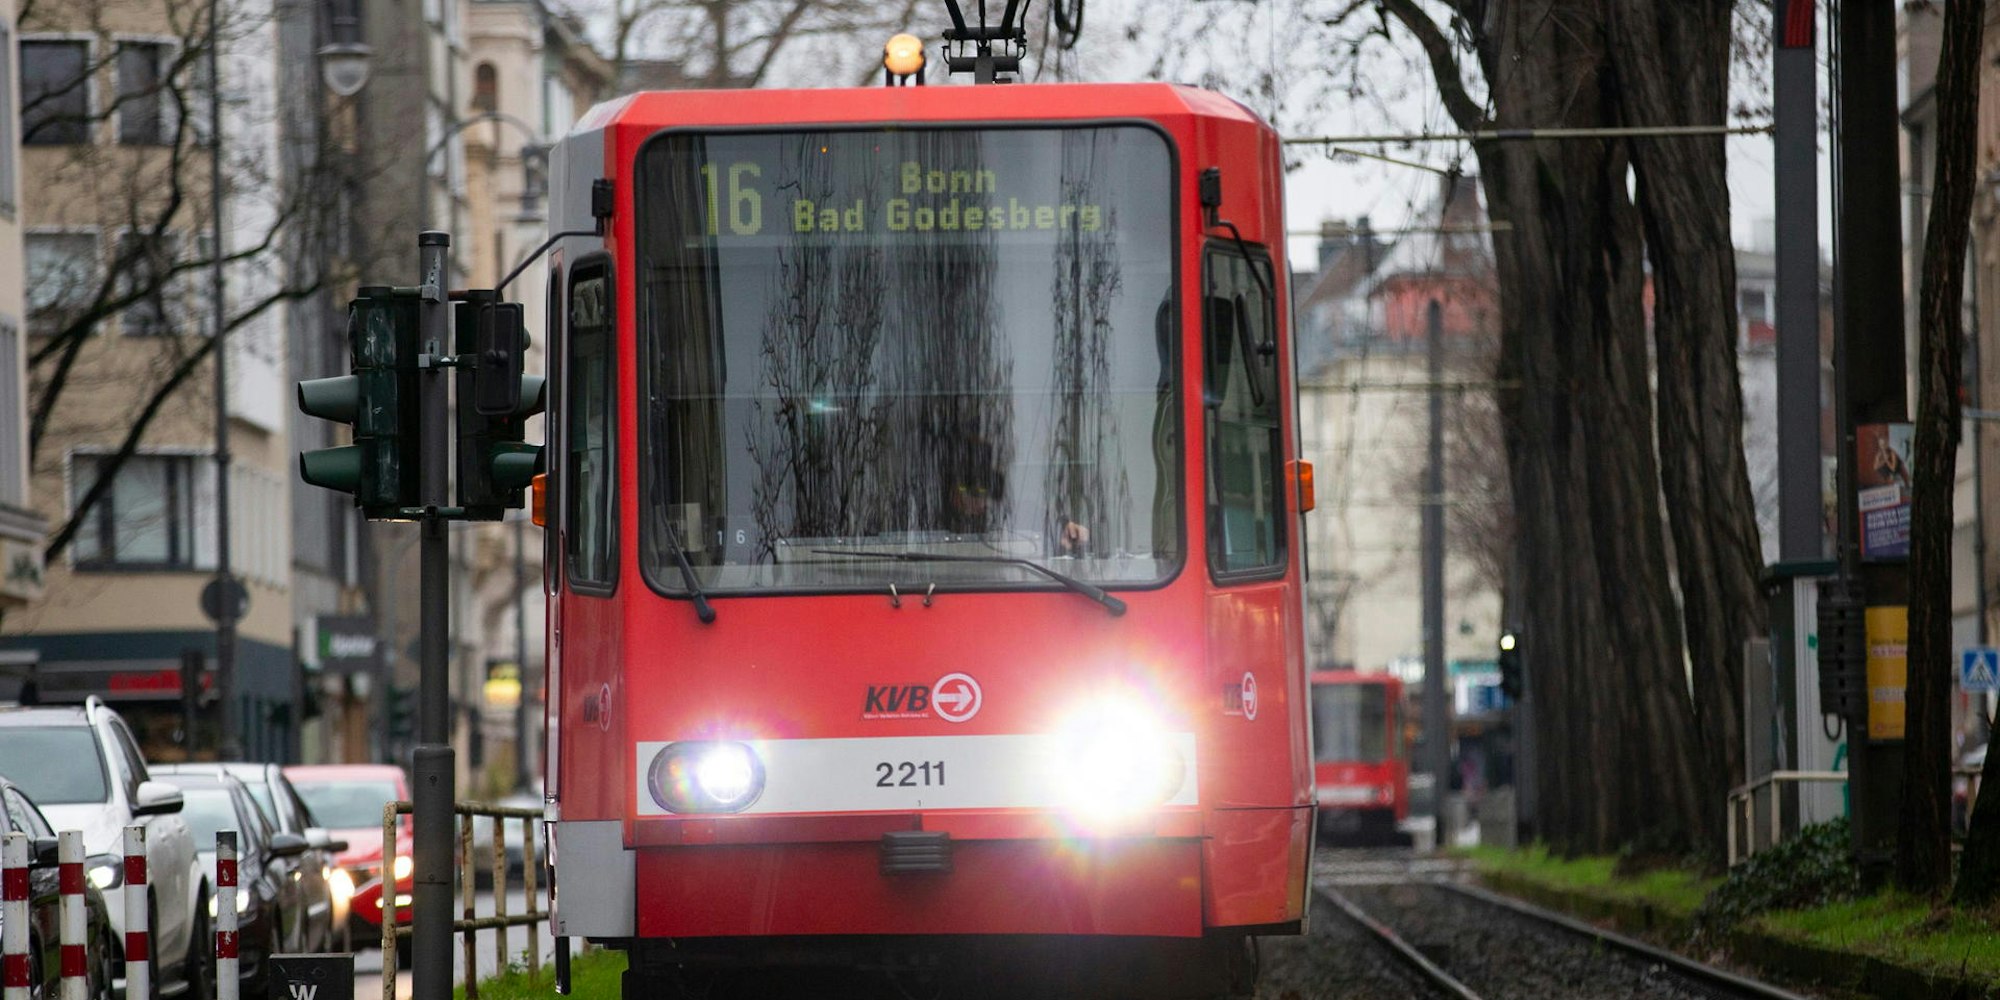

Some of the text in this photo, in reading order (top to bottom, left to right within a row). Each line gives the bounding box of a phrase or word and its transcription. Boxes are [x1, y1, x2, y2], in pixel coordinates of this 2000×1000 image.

[902, 162, 996, 194] Bonn
[701, 162, 762, 236] 16
[794, 198, 1101, 232] Bad Godesberg
[865, 685, 930, 713] KVB
[875, 760, 945, 788] 2211
